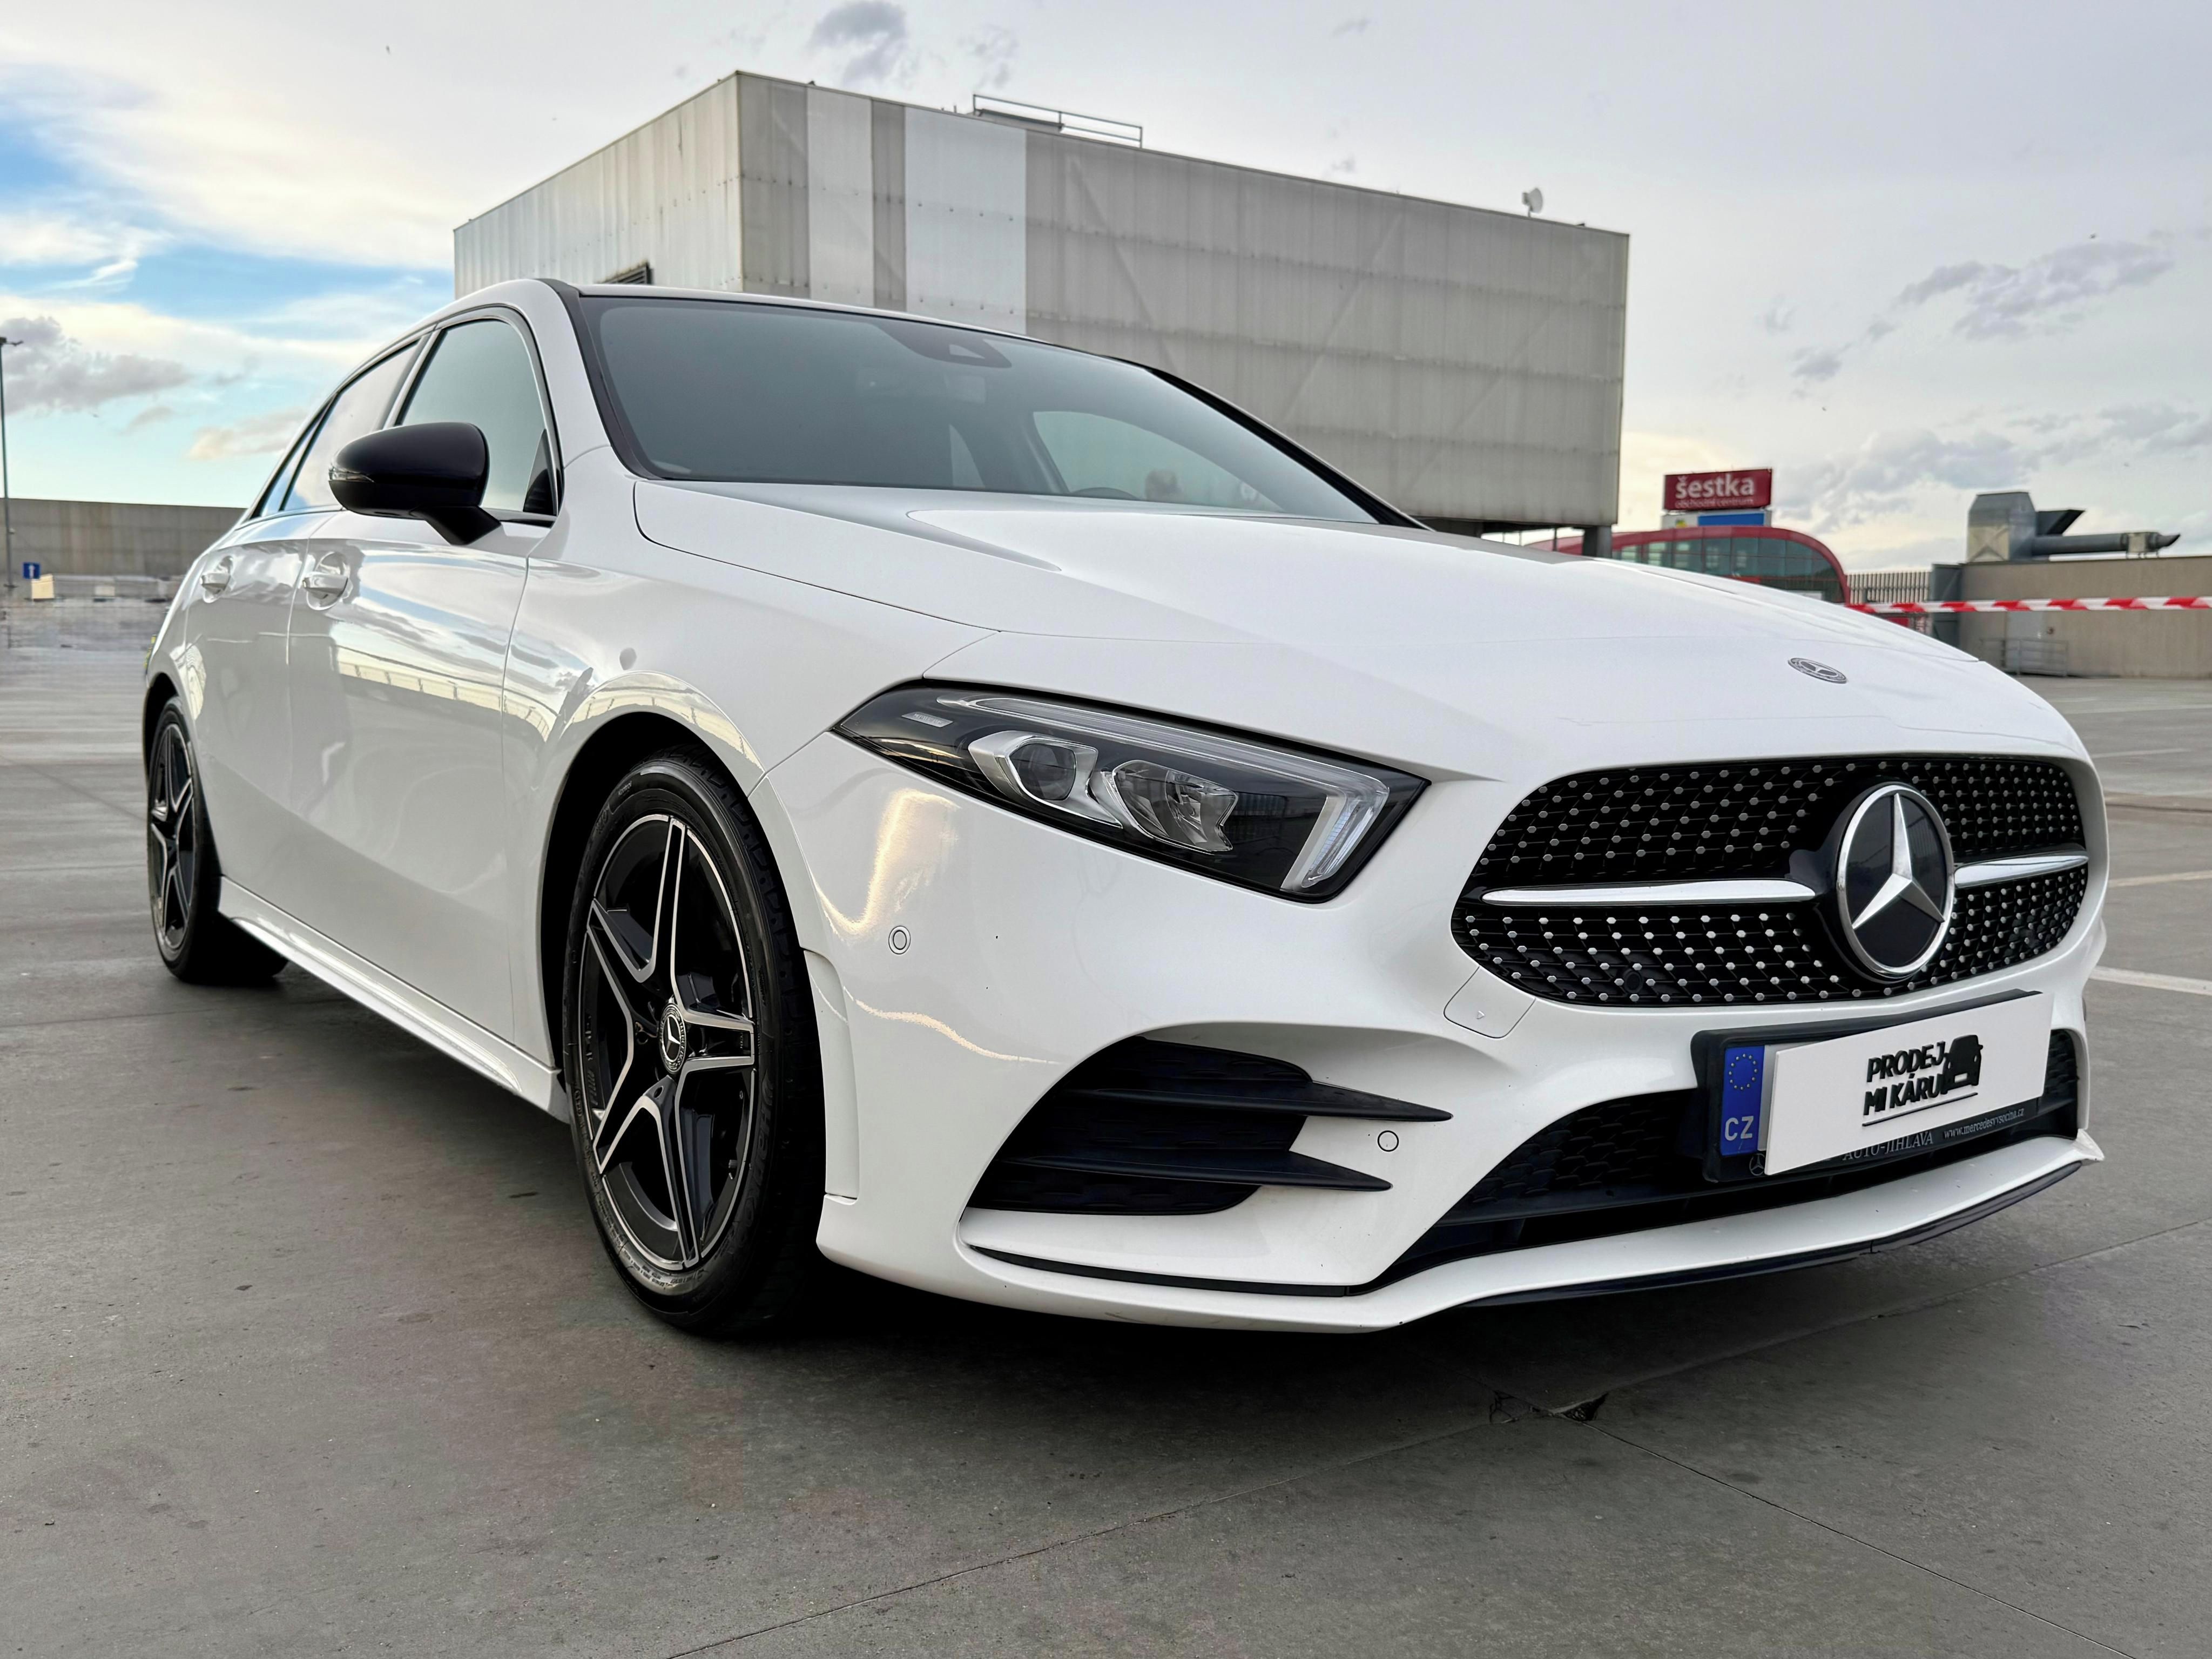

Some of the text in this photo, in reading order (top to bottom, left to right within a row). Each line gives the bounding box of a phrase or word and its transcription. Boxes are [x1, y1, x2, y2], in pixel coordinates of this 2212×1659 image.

[1675, 474, 1754, 499] šestka
[1866, 1041, 1945, 1082] PRODEJ
[1863, 1073, 1945, 1116] MI KÁRU
[1724, 1116, 1754, 1141] CZ
